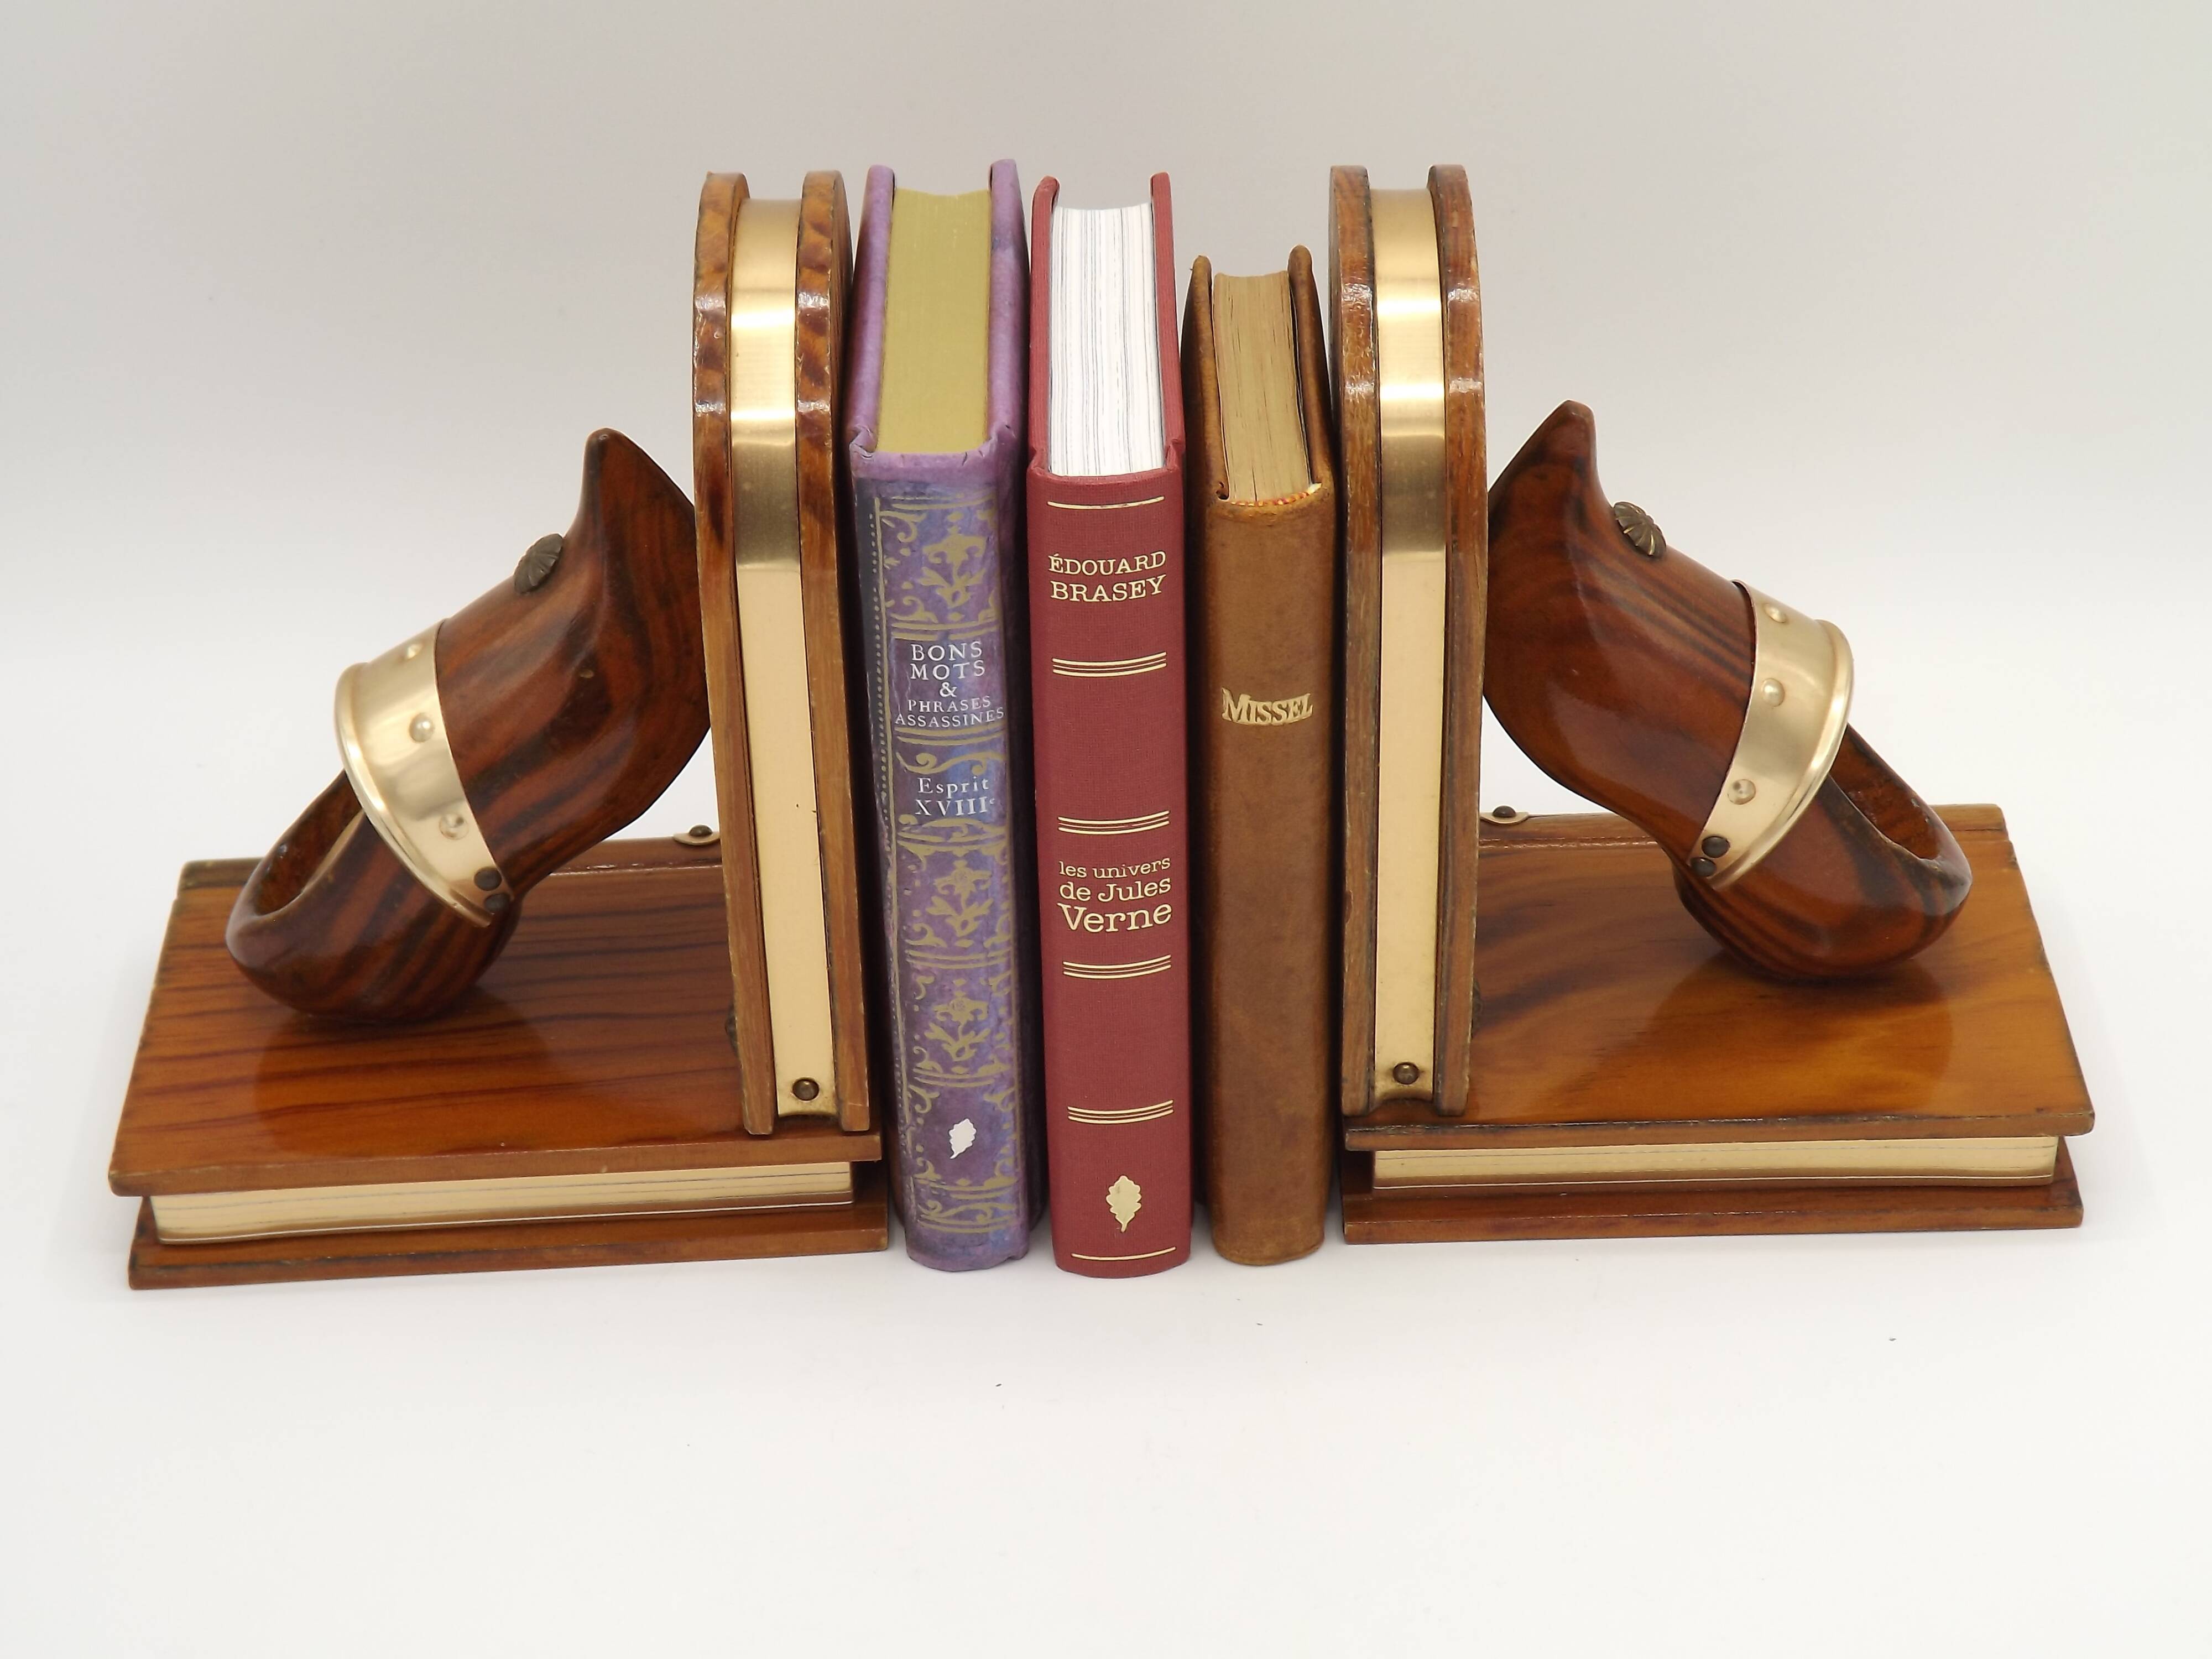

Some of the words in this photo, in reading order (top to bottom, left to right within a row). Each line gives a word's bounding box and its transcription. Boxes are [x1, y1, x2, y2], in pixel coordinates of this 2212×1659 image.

[1048, 551, 1166, 576] ÉDOUARD
[1051, 575, 1166, 602] BRASEY
[910, 641, 982, 661] BONS
[910, 660, 985, 680] MOTS
[939, 682, 957, 697] &
[908, 695, 992, 713] PHRASES
[895, 707, 1005, 728] ASSASSINES
[917, 775, 989, 799] Esprit
[1059, 861, 1087, 878] les
[1092, 857, 1171, 879] univers
[1060, 881, 1092, 901] de
[1097, 878, 1171, 902] Jules
[1057, 902, 1172, 933] Verne
